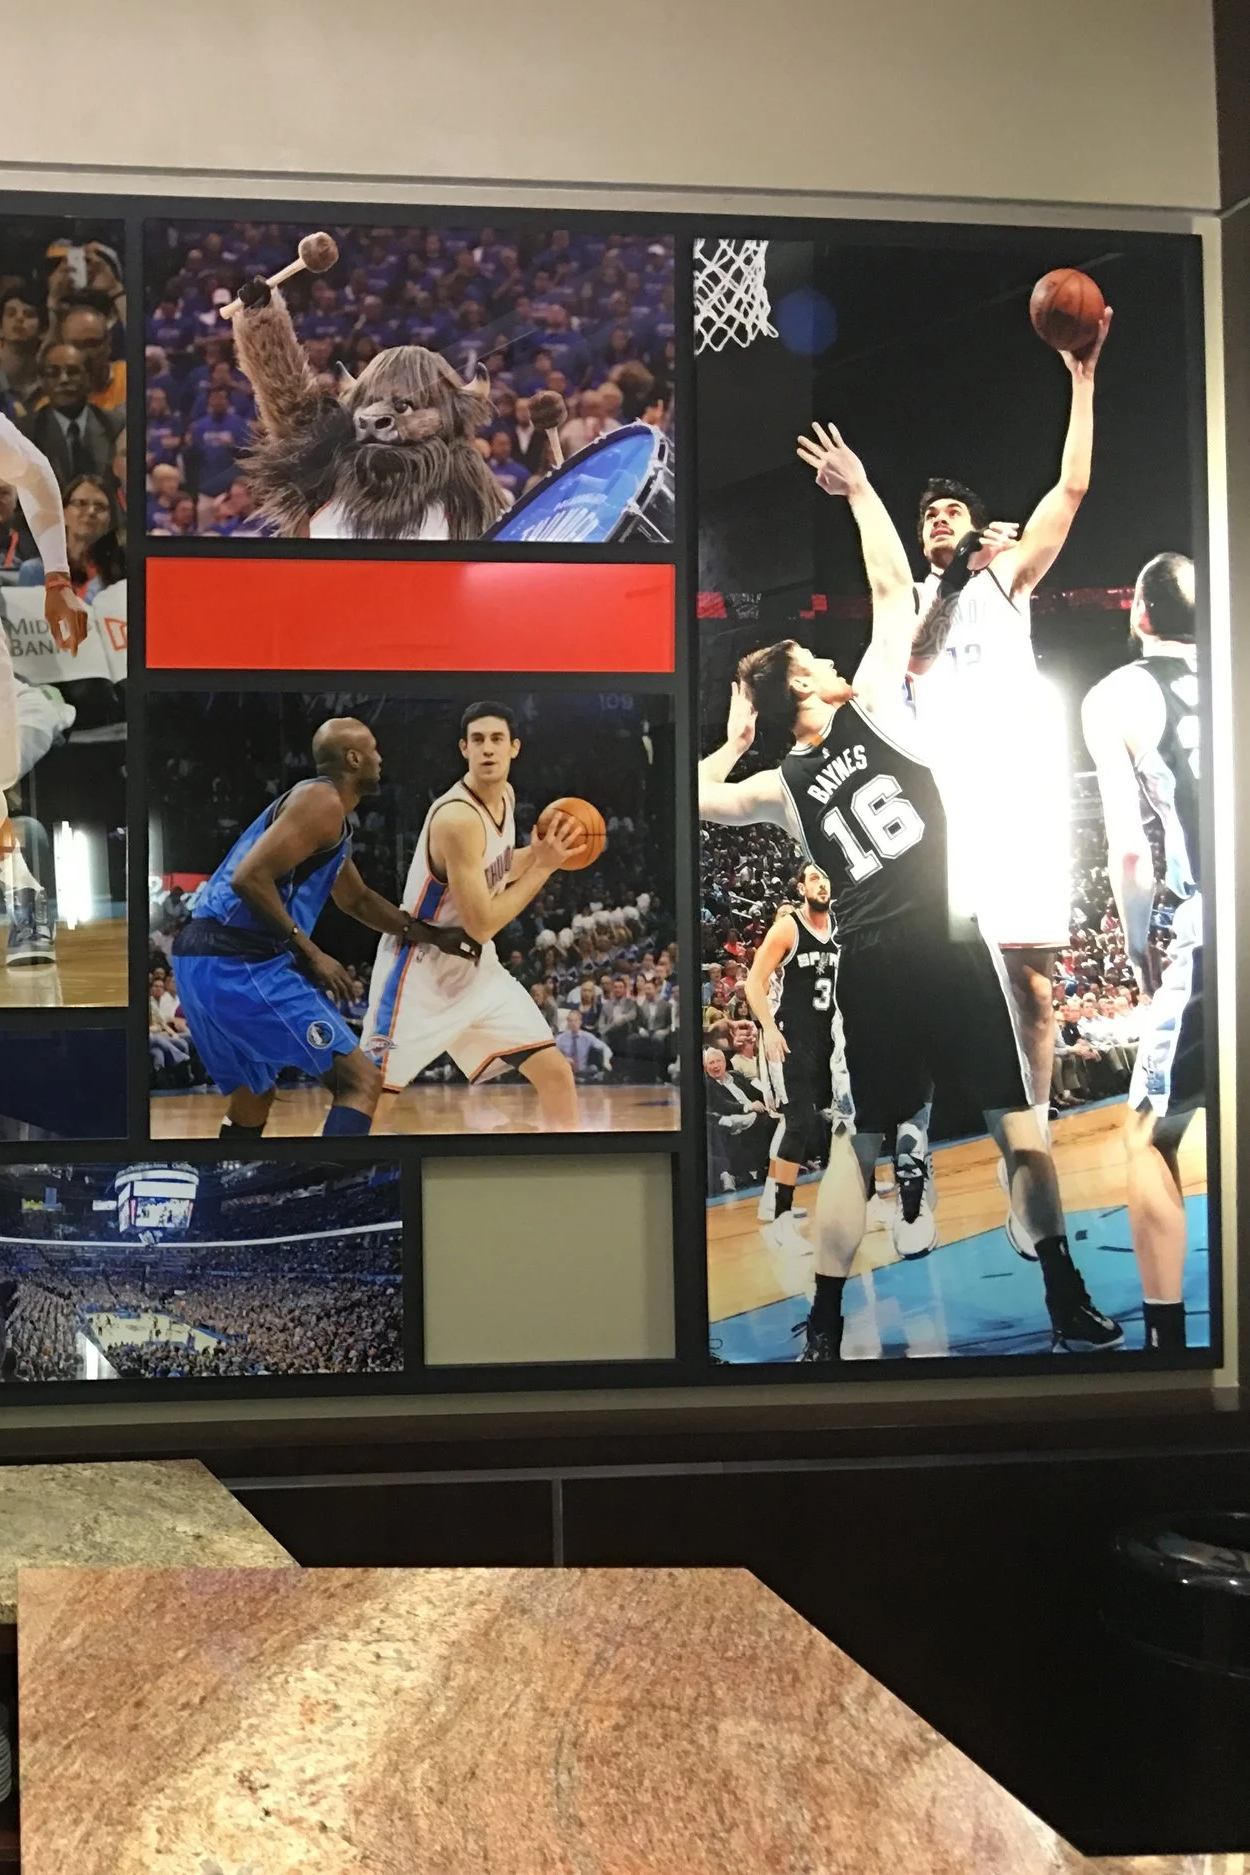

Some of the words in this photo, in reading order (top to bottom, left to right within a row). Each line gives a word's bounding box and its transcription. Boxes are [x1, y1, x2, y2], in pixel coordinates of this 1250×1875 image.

[10, 639, 61, 656] BAN
[807, 744, 868, 804] BAYNES
[820, 774, 925, 888] 16
